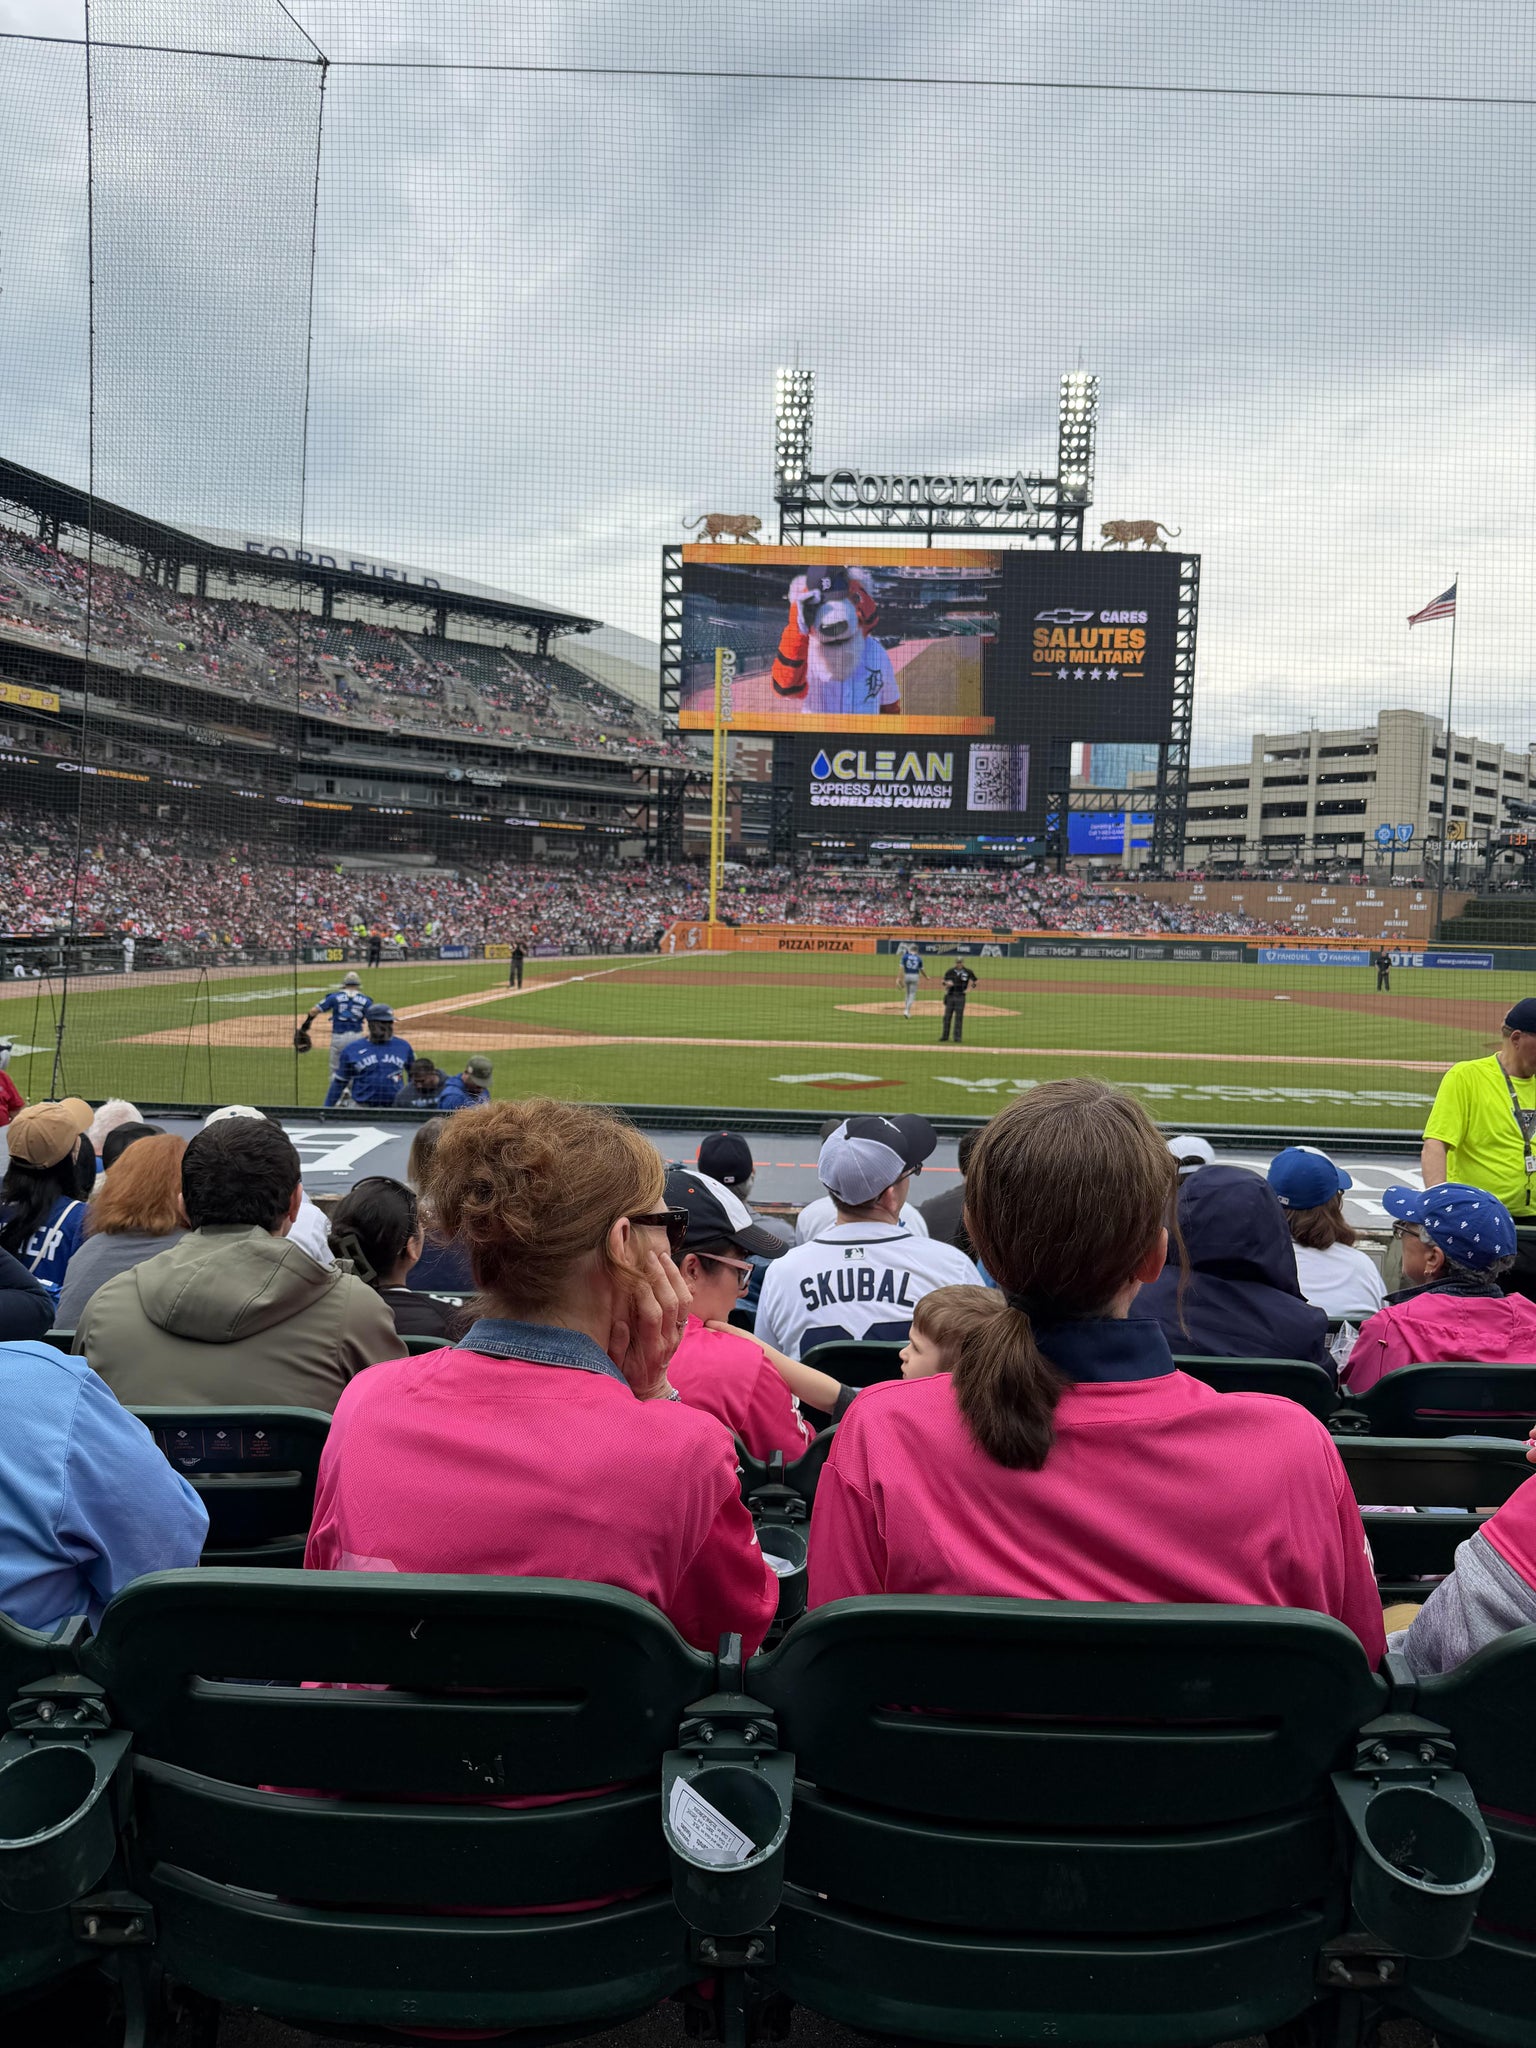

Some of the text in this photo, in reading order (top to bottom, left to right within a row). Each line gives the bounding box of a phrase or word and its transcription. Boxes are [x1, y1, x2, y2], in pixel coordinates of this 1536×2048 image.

[881, 508, 980, 527] PARK
[1100, 610, 1148, 623] CARES
[1033, 627, 1146, 649] SALUTES
[1032, 649, 1145, 664] OUR MILITARY
[832, 750, 954, 781] CLEAN
[810, 782, 952, 798] EXPRESS AUTO WASH
[810, 796, 951, 809] SCORELESS FOURTH
[1431, 840, 1478, 850] BTMGM
[1365, 889, 1375, 899] 16
[1295, 904, 1306, 914] 47
[1341, 906, 1349, 916] 3
[779, 939, 854, 951] PIZZA! PIZZA!
[312, 949, 344, 961] bet365
[381, 1053, 405, 1069] JAY
[799, 1267, 915, 1312] SKUBAL
